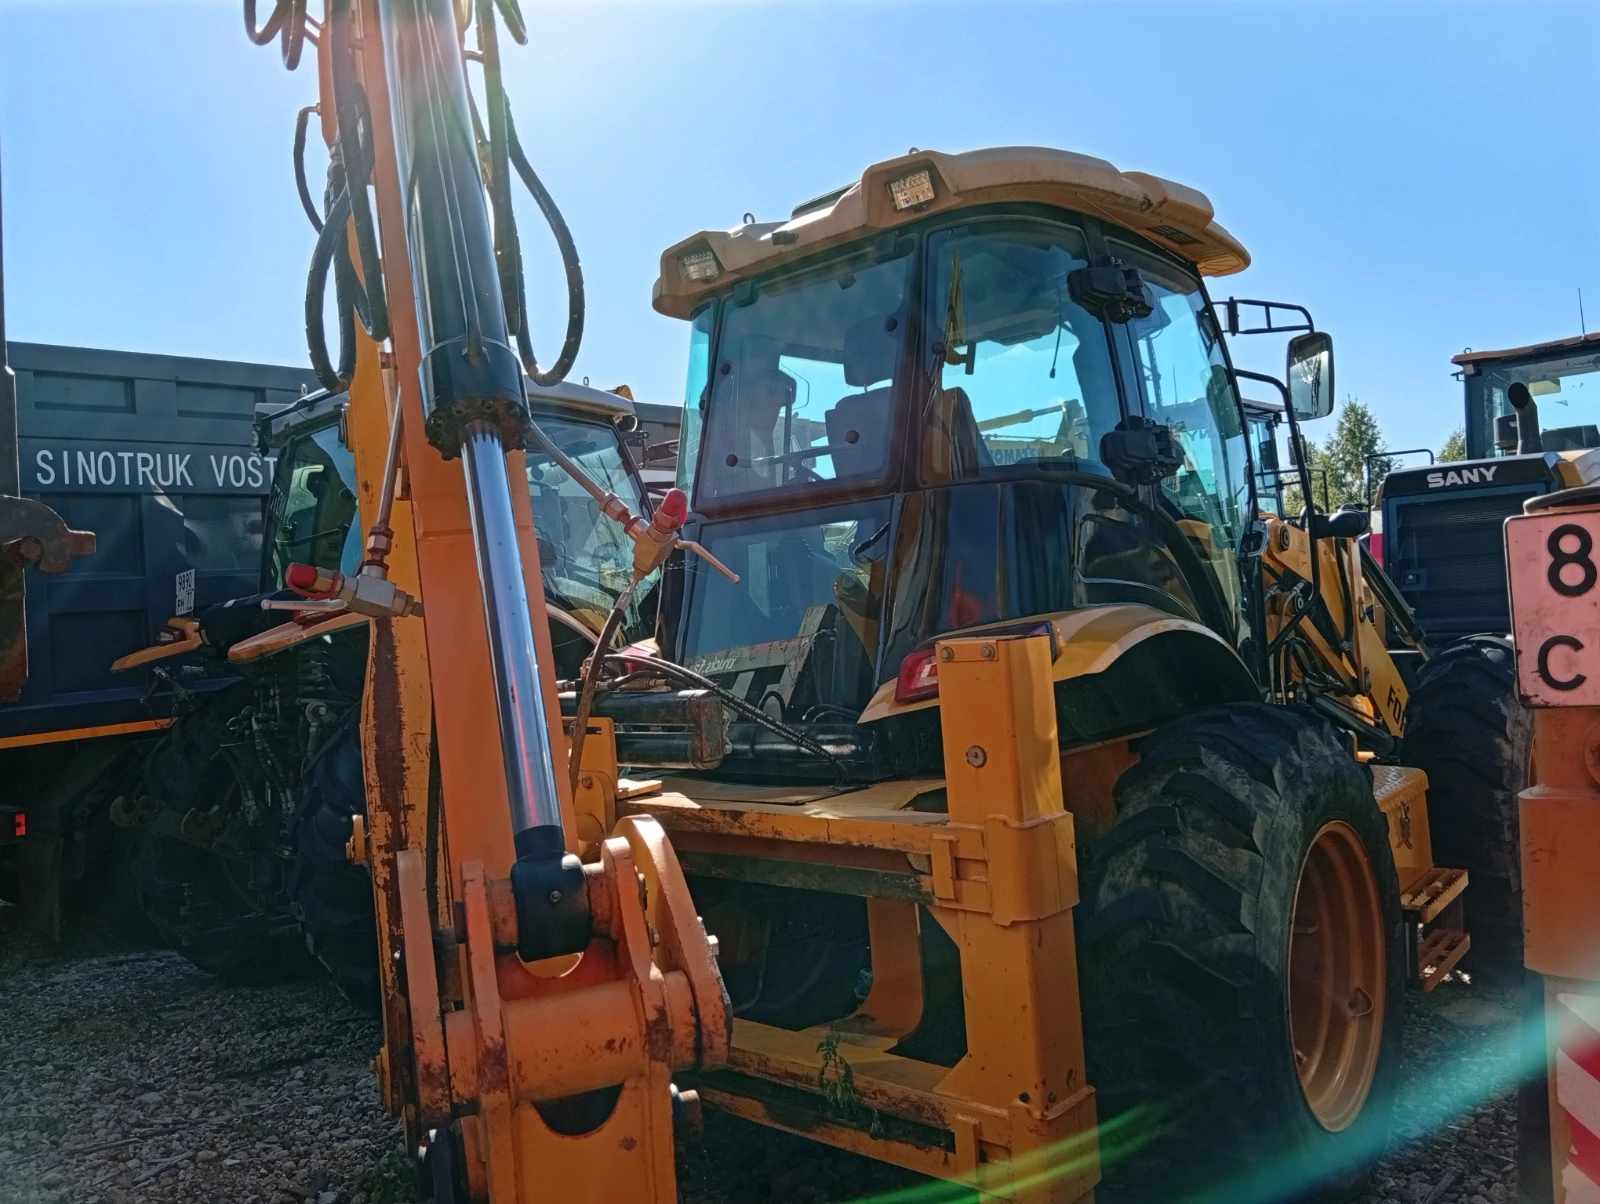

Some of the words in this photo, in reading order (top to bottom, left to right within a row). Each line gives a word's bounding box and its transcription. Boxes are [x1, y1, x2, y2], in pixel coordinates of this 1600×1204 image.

[36, 449, 194, 488] SINOTRUK
[1426, 465, 1498, 489] SANY
[1546, 523, 1598, 597] 8
[1537, 634, 1587, 691] C
